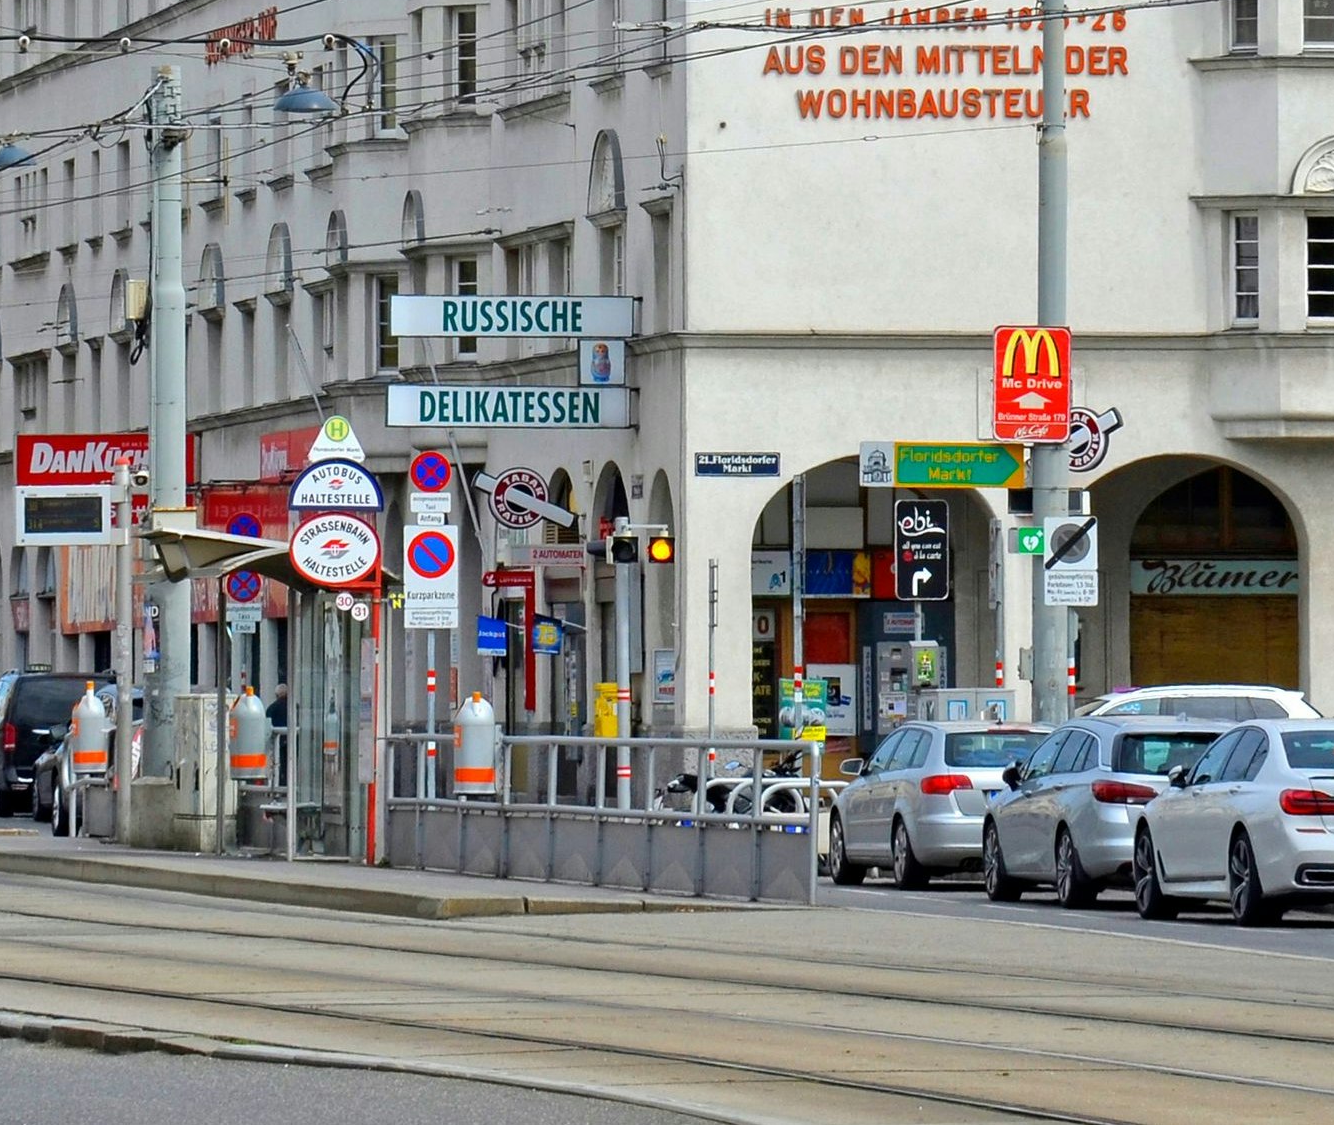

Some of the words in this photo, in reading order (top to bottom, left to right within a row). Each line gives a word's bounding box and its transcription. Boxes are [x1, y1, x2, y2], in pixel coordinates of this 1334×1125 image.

[764, 8, 791, 29] IN
[810, 8, 864, 29] DEN
[883, 8, 988, 30] JAHREN
[763, 45, 826, 75] AUS
[840, 45, 903, 75] DEN
[1065, 45, 1129, 75] DER
[797, 88, 1091, 119] WOHNBAUSTEUR
[442, 299, 583, 333] RUSSISCHE
[1002, 378, 1023, 389] Mc
[1026, 378, 1063, 389] Drive
[419, 390, 600, 424] DELIKATESSEN
[998, 412, 1027, 422] Brünner
[1028, 412, 1051, 422] Straße
[330, 422, 343, 437] H
[899, 446, 1000, 464] Floridsdorfer
[312, 466, 363, 485] AUTOBUS
[723, 464, 752, 473] Markt
[928, 466, 972, 481] Markt
[503, 473, 545, 497] TABAK
[301, 493, 371, 505] HALTESTELLE
[495, 493, 534, 524] TRAFIK
[420, 515, 442, 524] Anfang
[300, 520, 370, 546] STRASSENBAHN
[532, 549, 537, 559] 2
[538, 549, 584, 559] AUTOMATEN
[303, 556, 368, 578] HALTESTELLE
[337, 596, 353, 607] 30
[407, 590, 455, 602] Kurzparkzone
[354, 607, 367, 617] 31
[478, 630, 506, 639] Jackpot
